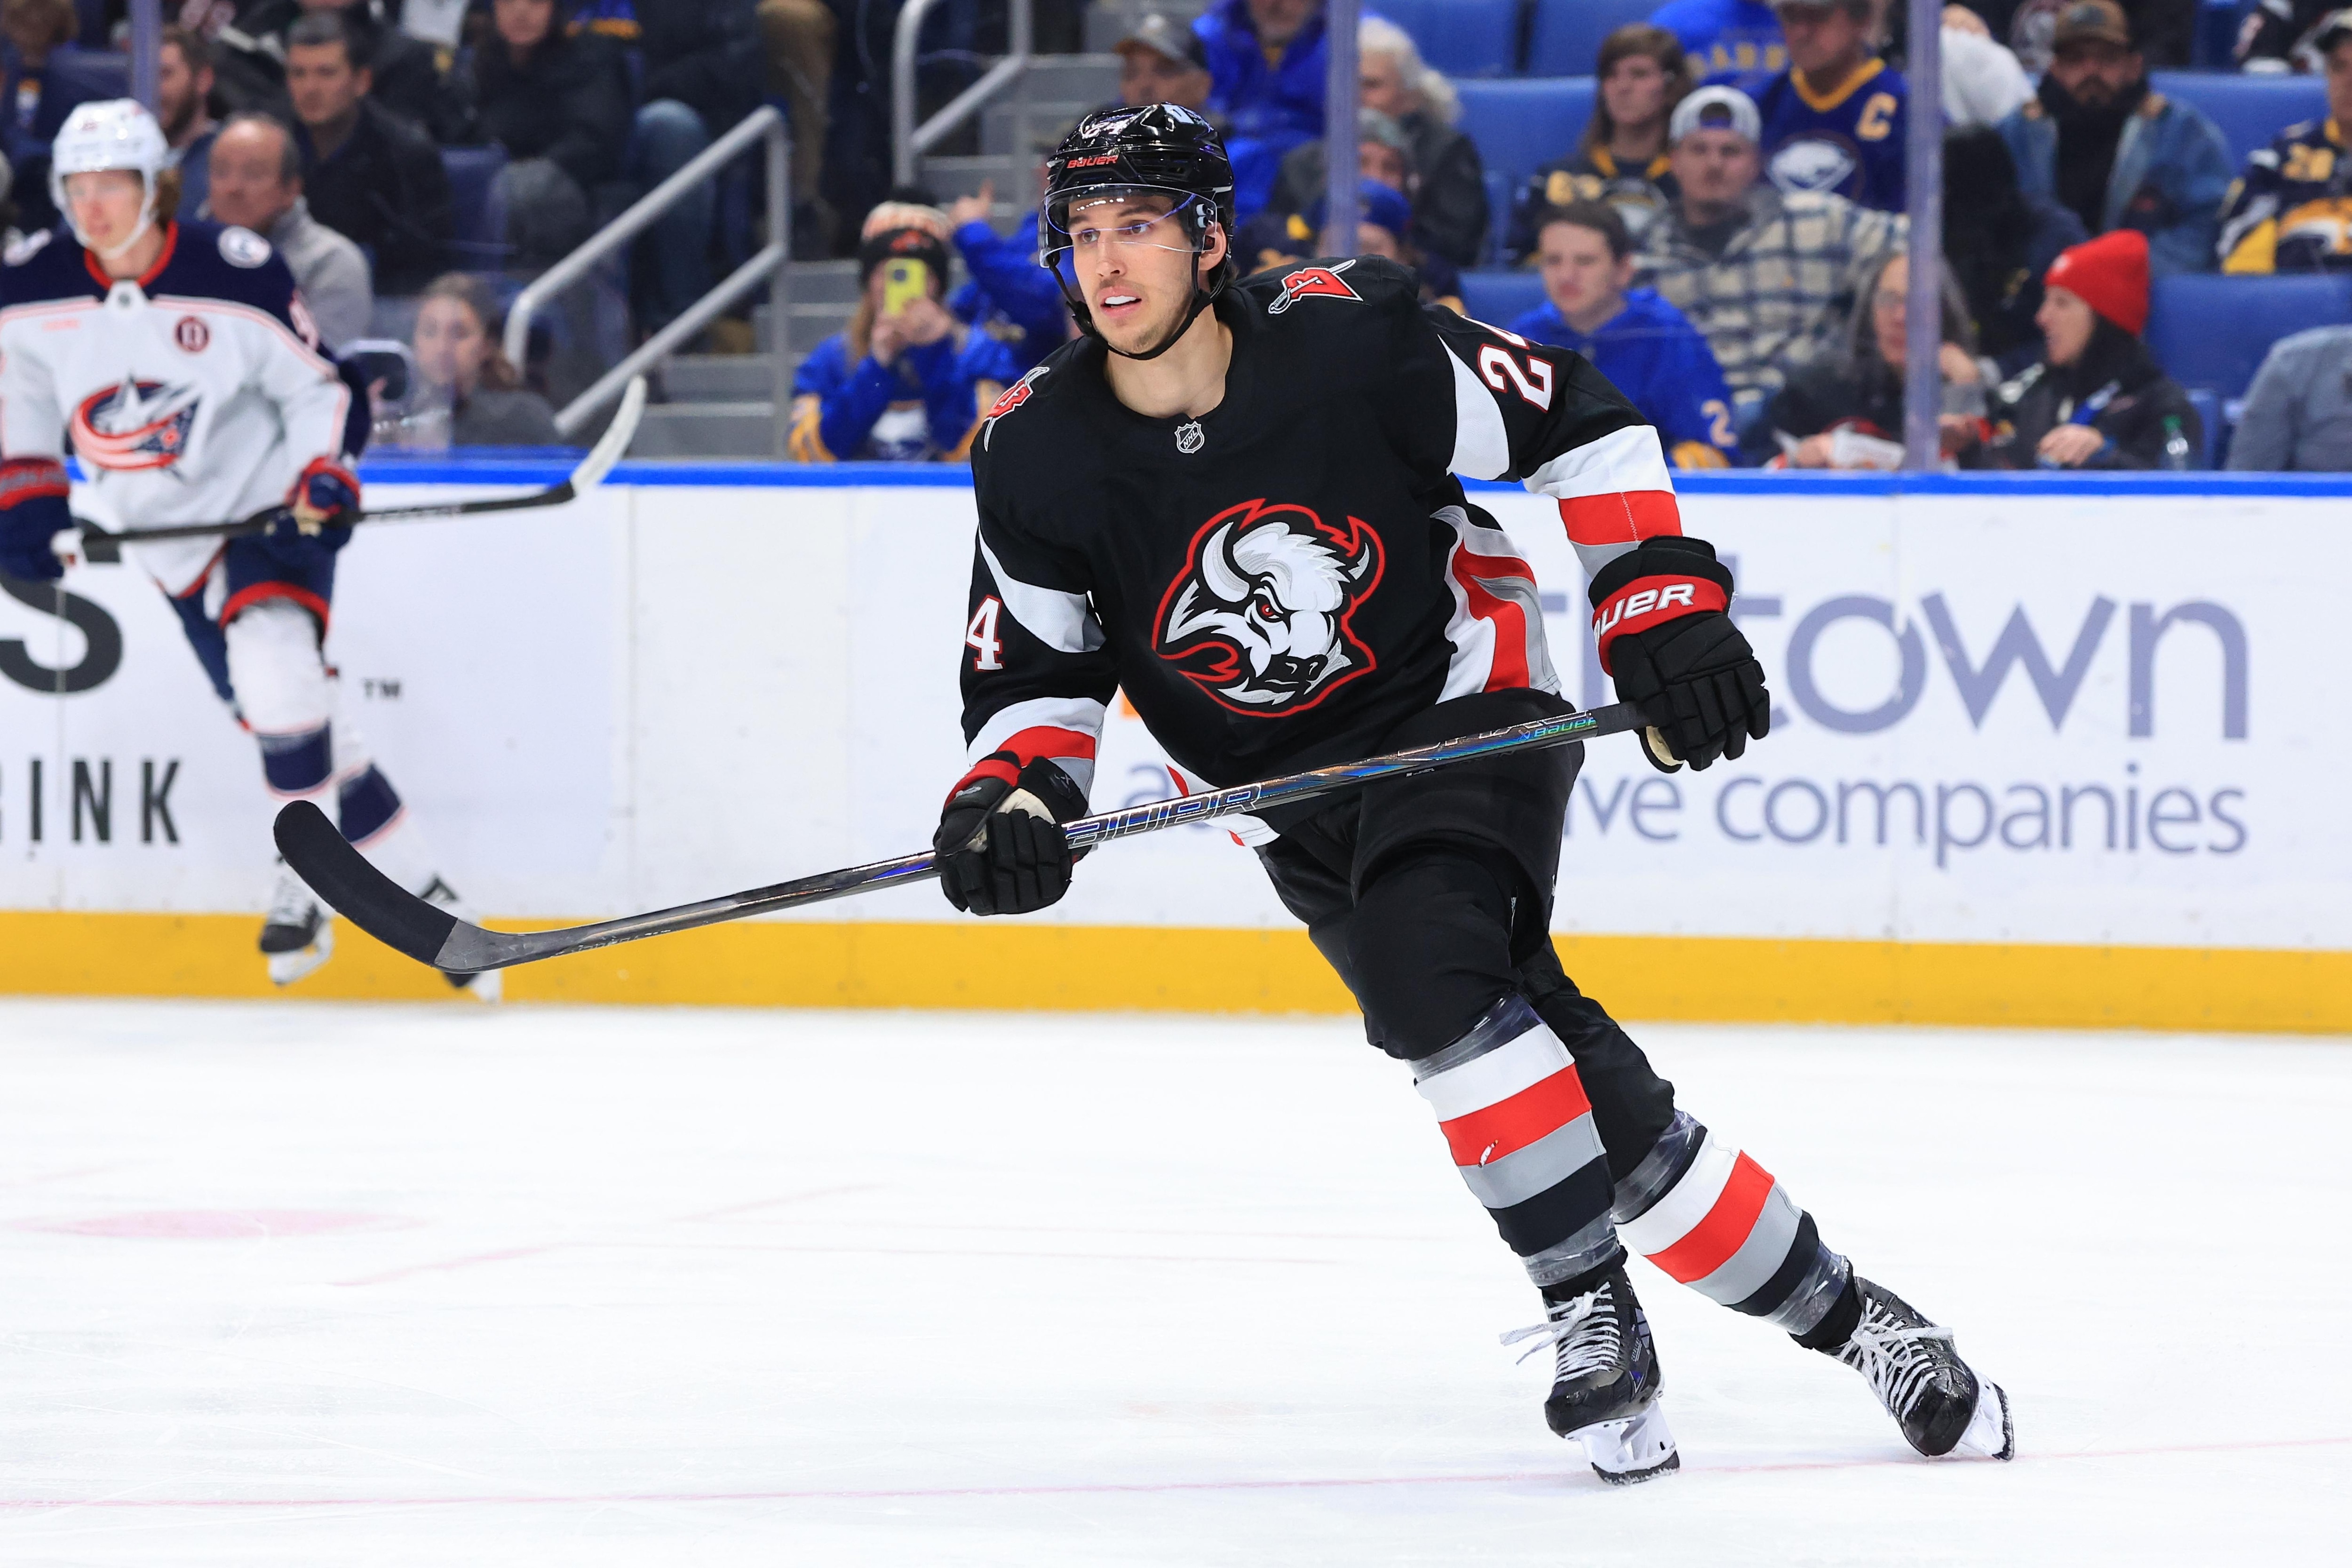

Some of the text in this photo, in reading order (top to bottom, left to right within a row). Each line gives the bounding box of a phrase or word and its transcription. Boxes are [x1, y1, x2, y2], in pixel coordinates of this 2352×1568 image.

[1855, 92, 1897, 140] C
[1066, 155, 1119, 168] BAUER
[1183, 430, 1197, 448] NHL
[1701, 399, 1738, 447] 2
[965, 594, 1005, 671] 4
[0, 759, 180, 844] INK
[1716, 763, 2248, 870] companies
